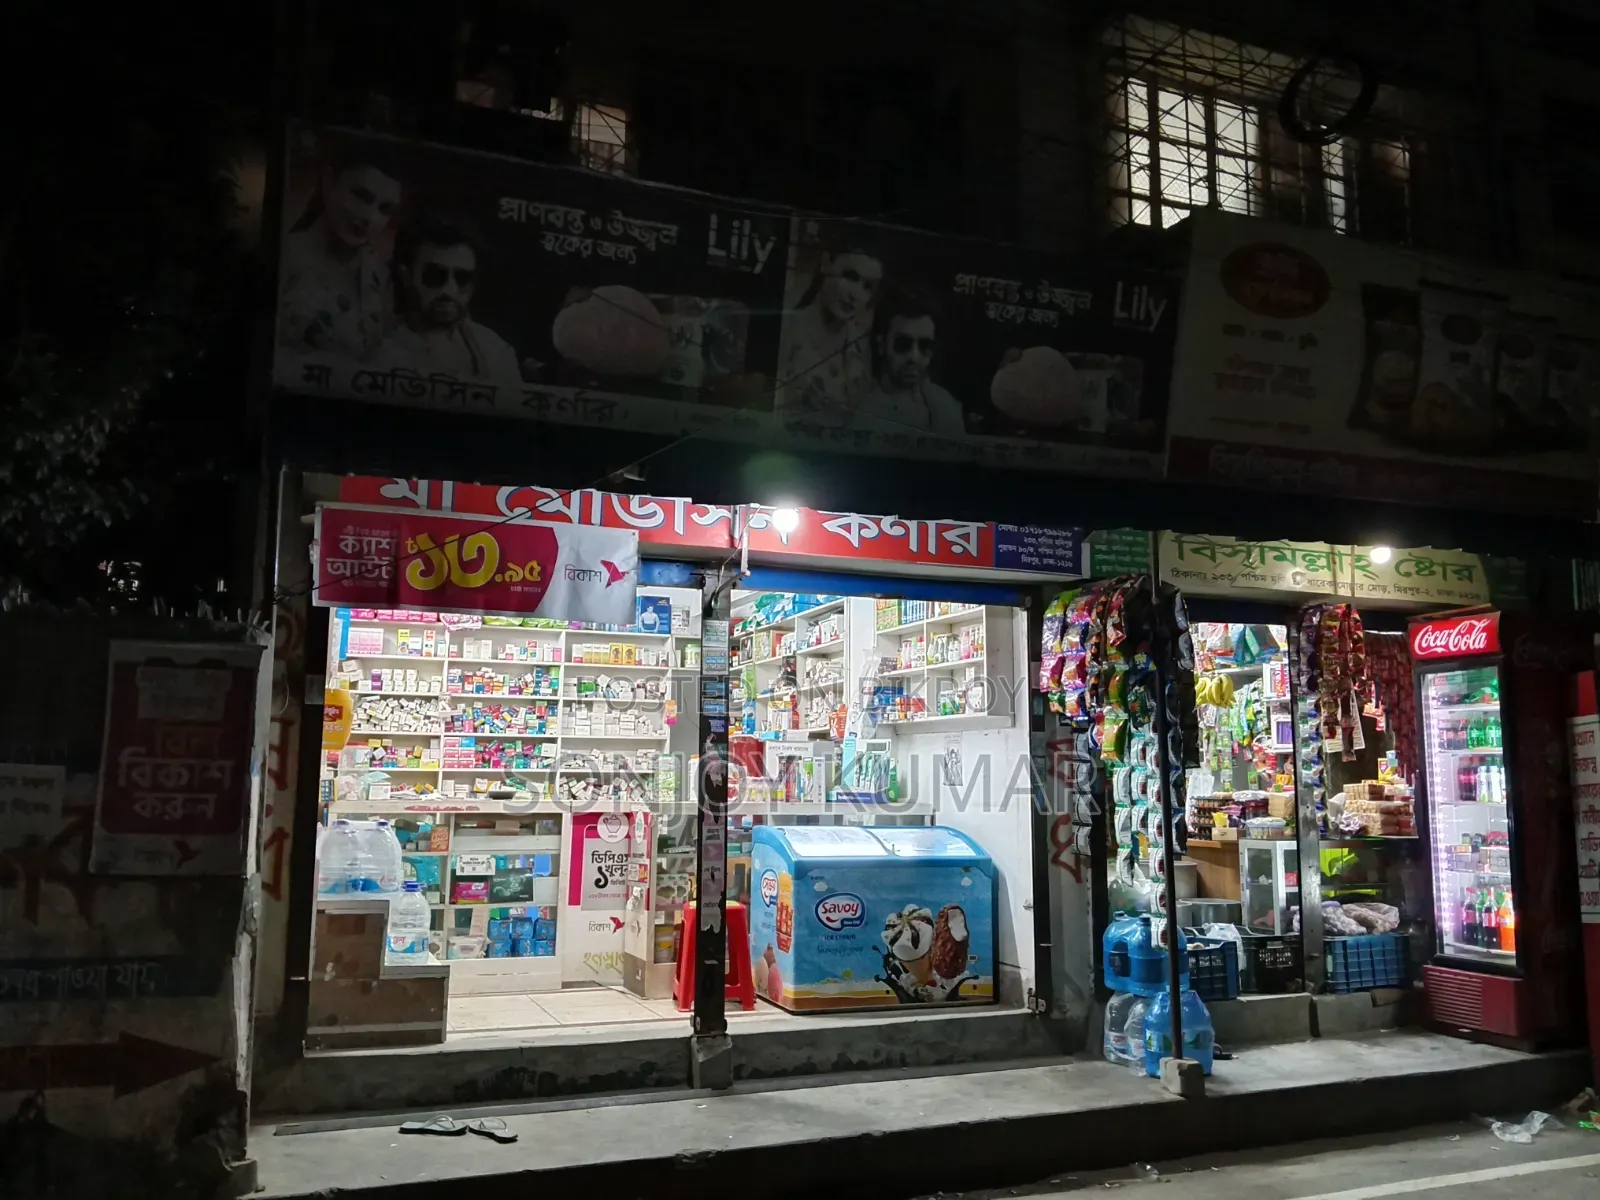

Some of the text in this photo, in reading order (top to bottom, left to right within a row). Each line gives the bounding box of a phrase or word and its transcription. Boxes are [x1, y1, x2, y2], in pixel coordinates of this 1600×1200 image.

[497, 197, 679, 252] প্রাণবন্ত ও উজ্জ্বল
[540, 231, 637, 264] ত্বকের জন্য
[707, 212, 777, 275] Lily
[1113, 280, 1168, 333] Lily
[303, 363, 332, 389] মা
[350, 366, 499, 409] মেডিসিন
[338, 535, 397, 555] ক্যাশ
[326, 555, 396, 580] আউট
[564, 563, 602, 583] বিকাশ
[1414, 618, 1493, 656] Coca-Cola
[118, 746, 236, 790] বিকাশ
[588, 920, 611, 932] বিকাশ
[821, 901, 860, 917] Savoy
